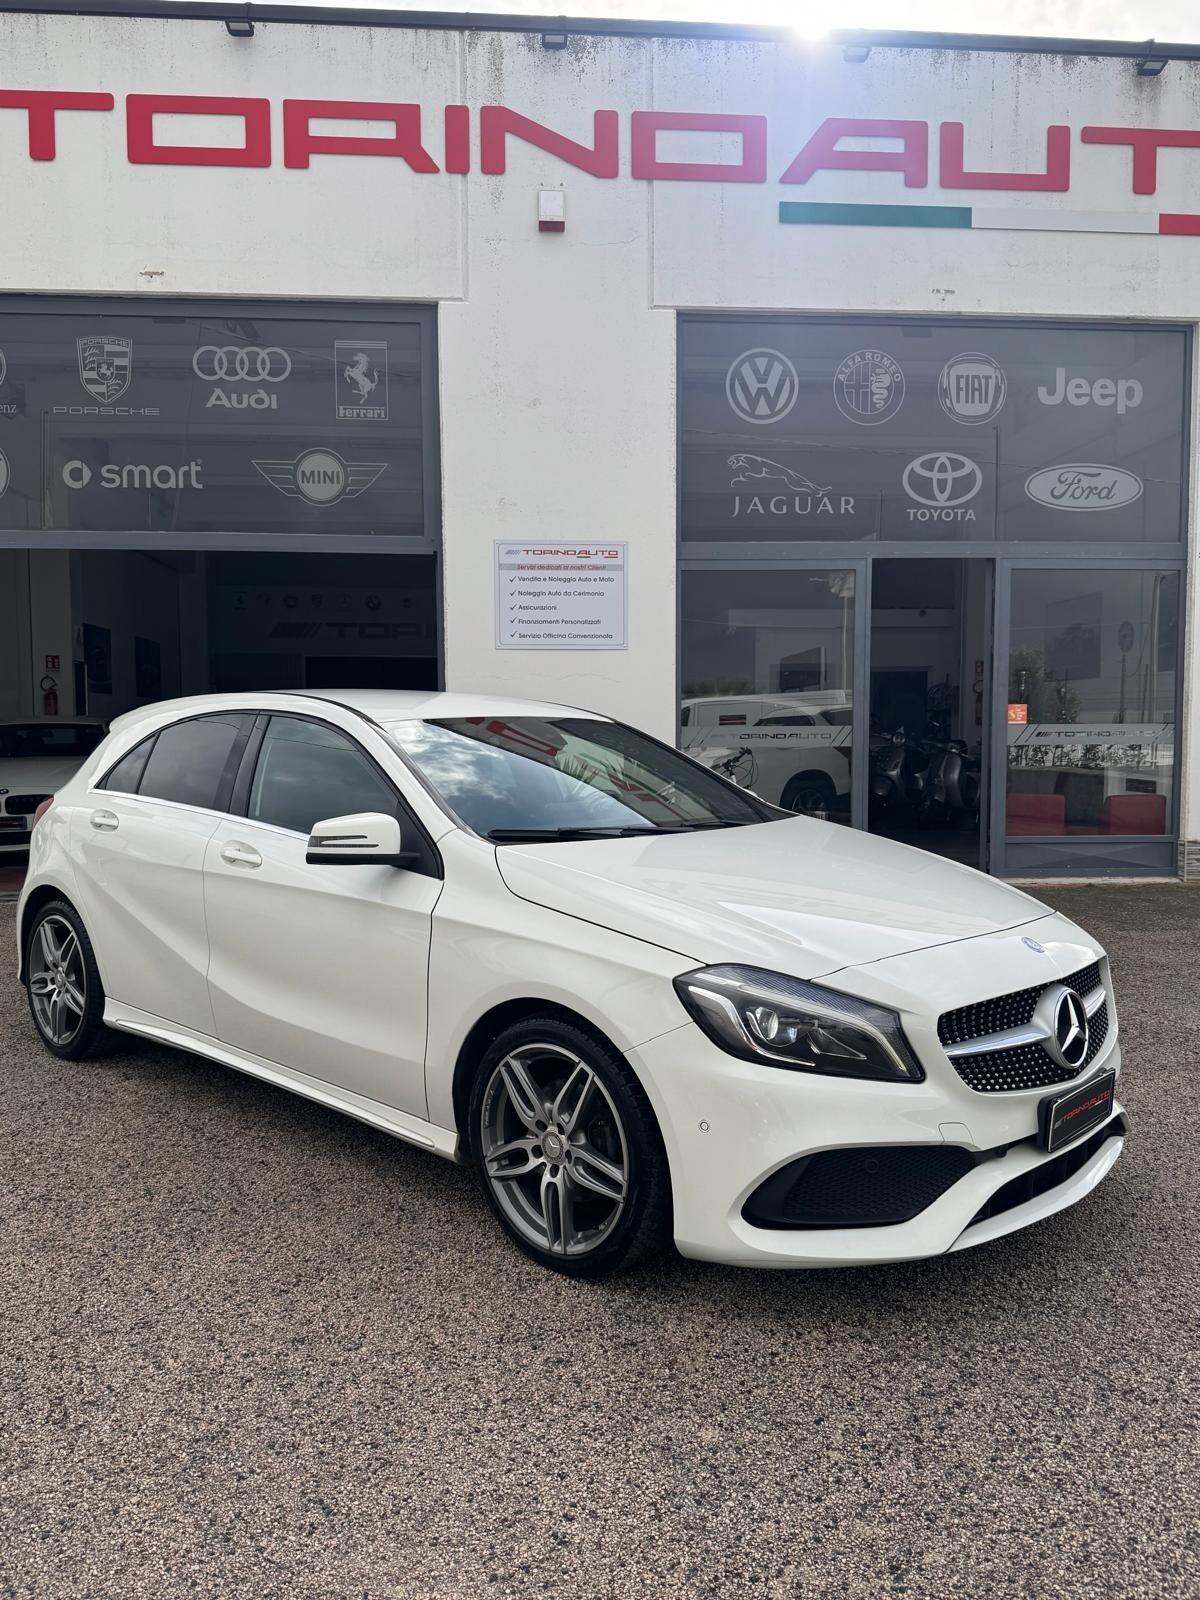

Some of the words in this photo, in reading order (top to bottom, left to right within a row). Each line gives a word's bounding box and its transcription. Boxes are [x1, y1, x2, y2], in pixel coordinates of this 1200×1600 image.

[837, 355, 863, 382] ALFA
[865, 352, 901, 382] ROMEO
[206, 388, 277, 409] Audi
[955, 374, 992, 404] FIAT
[1037, 367, 1144, 414] Jeep
[53, 406, 160, 416] PORSCHE
[338, 406, 386, 418] Ferrari
[100, 459, 204, 489] smart
[301, 470, 340, 485] MINI
[1051, 470, 1119, 500] Ford
[732, 496, 855, 517] JAGUAR
[906, 509, 976, 521] TOYOTA
